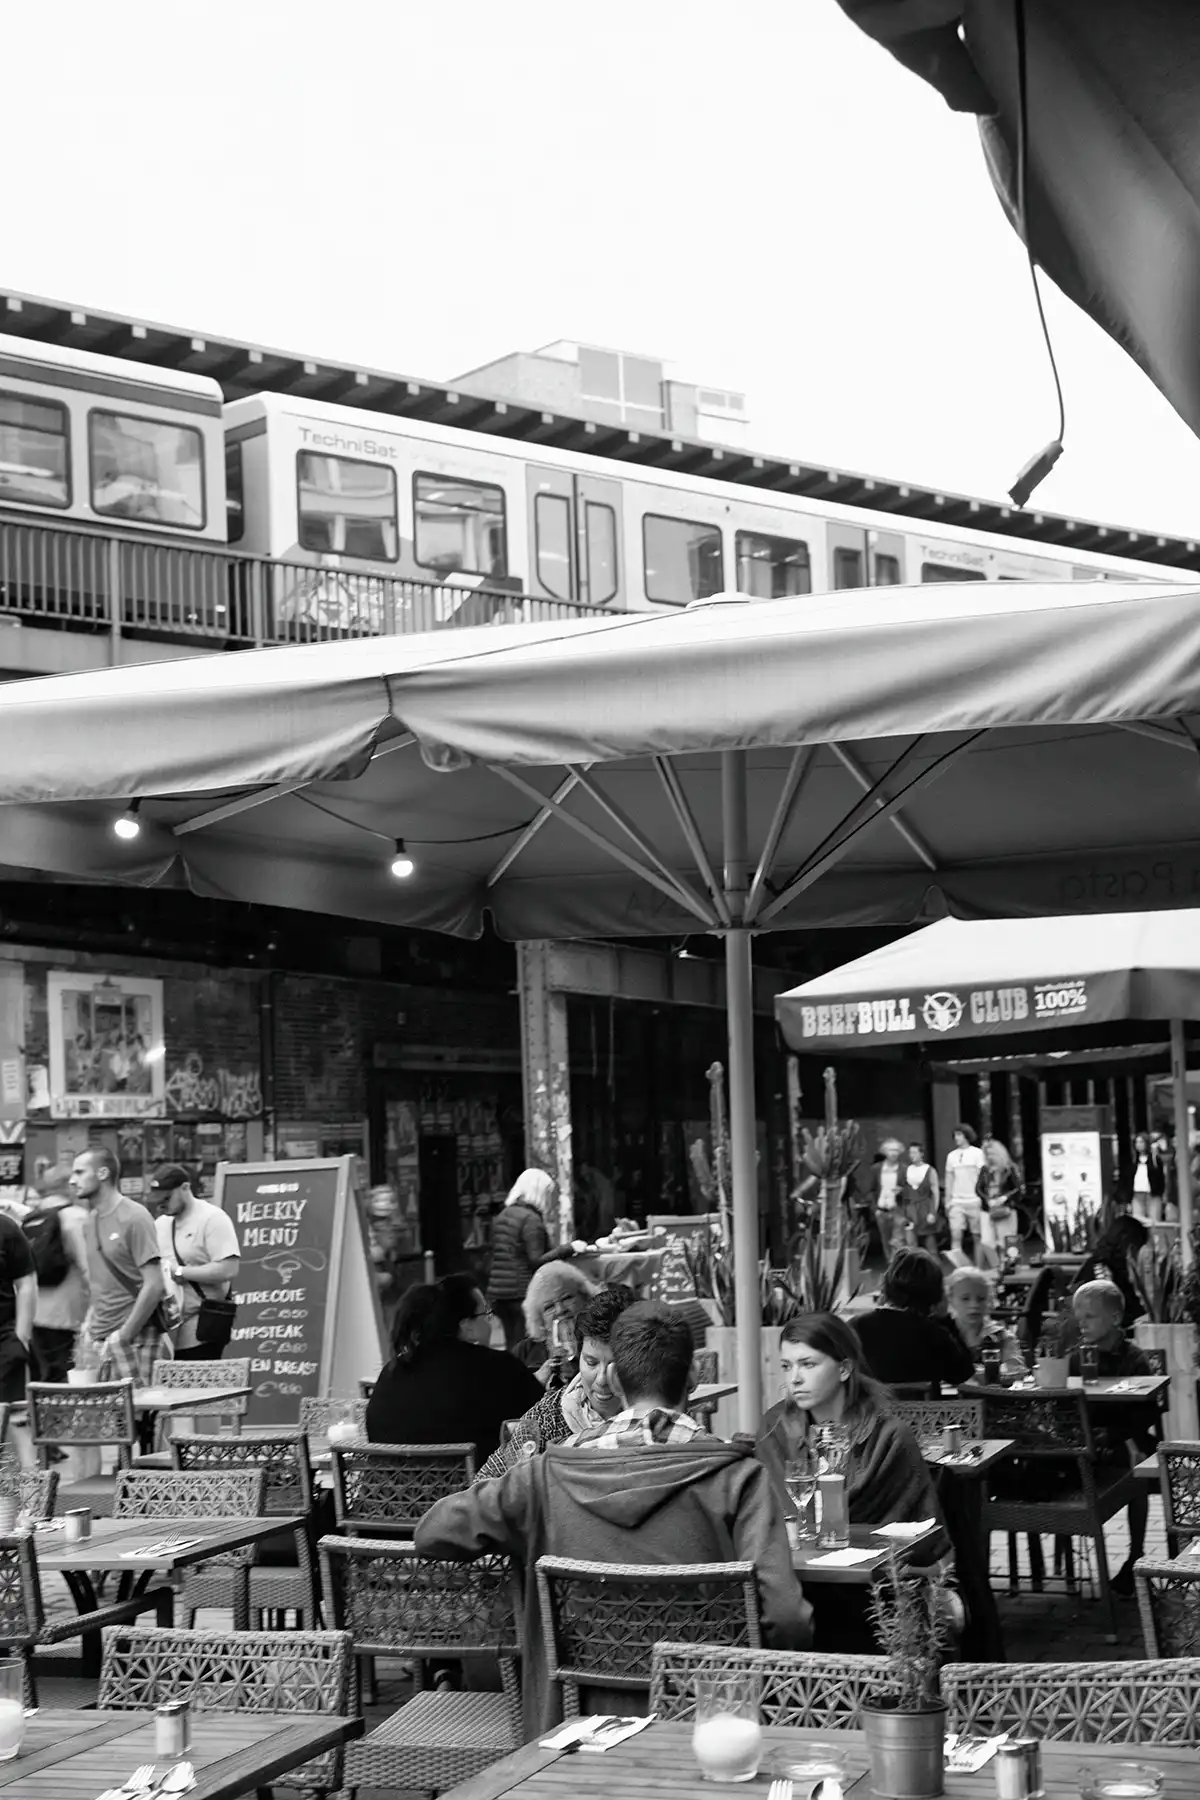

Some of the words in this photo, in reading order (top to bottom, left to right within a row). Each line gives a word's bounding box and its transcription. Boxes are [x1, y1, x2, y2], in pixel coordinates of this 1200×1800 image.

[298, 427, 398, 458] TechniSat
[801, 998, 916, 1037] BEEFBULL
[970, 987, 1029, 1024] CLUB
[1034, 987, 1088, 1010] 100%
[230, 1324, 305, 1341] UMPSTEAK
